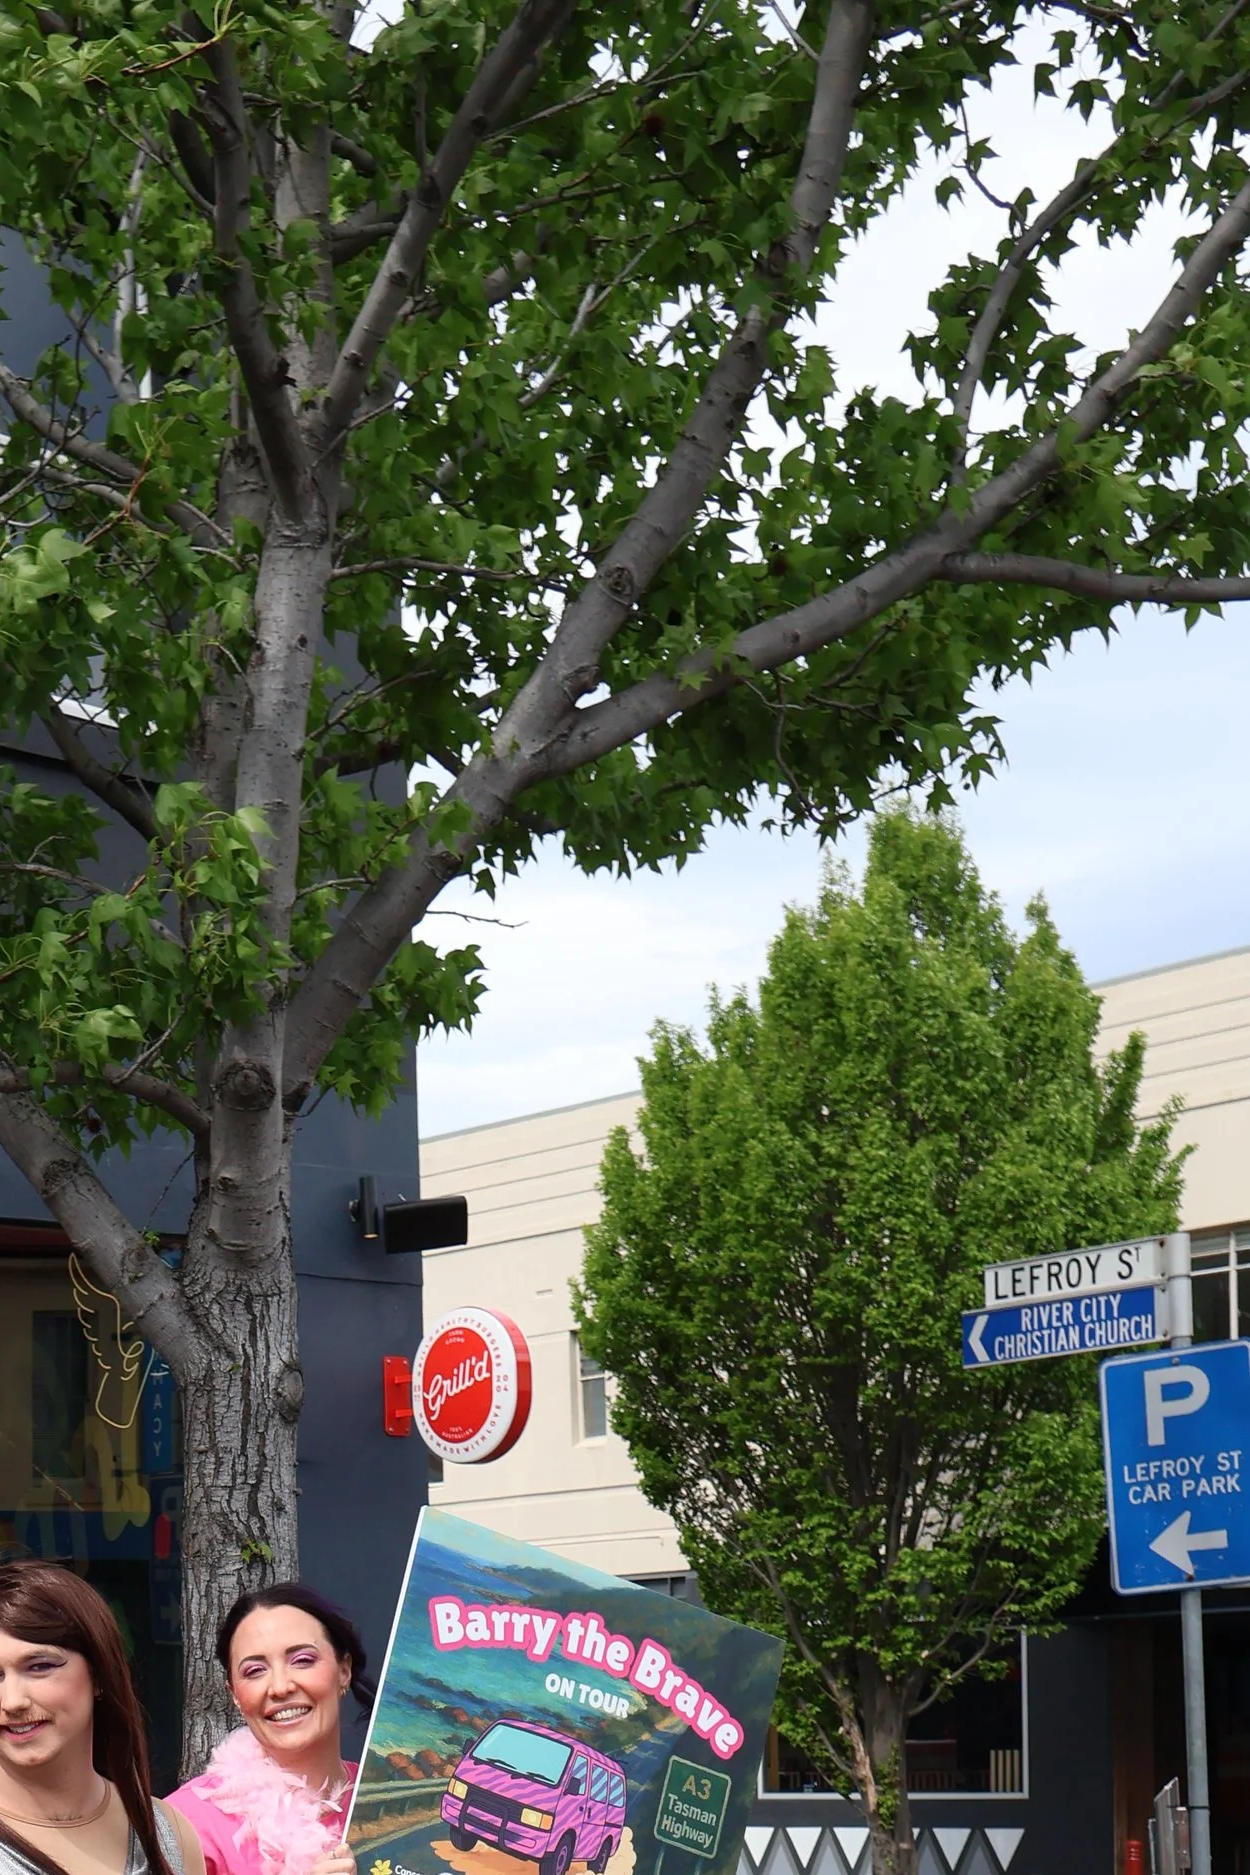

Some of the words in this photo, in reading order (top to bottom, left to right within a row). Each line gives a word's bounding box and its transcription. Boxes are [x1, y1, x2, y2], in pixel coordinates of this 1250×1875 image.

[993, 1255, 1104, 1301] LEFROY
[1021, 1303, 1074, 1333] RIVER
[1080, 1293, 1123, 1325] CITY
[993, 1324, 1081, 1361] CHRISTIAN
[1084, 1313, 1155, 1347] CHURCH
[423, 1350, 491, 1421] Grill'd
[1143, 1364, 1212, 1447] P
[1123, 1454, 1206, 1484] LEFROY
[1216, 1450, 1243, 1472] ST
[1128, 1482, 1171, 1505] CAR
[1182, 1474, 1241, 1499] PARK
[434, 1602, 557, 1656] Barry
[567, 1618, 630, 1672] the
[633, 1645, 740, 1753] Brave
[545, 1673, 575, 1700] ON
[577, 1683, 630, 1719] TOUR
[682, 1775, 711, 1800] A3
[668, 1793, 717, 1826] Tasman
[660, 1814, 713, 1849] Highway
